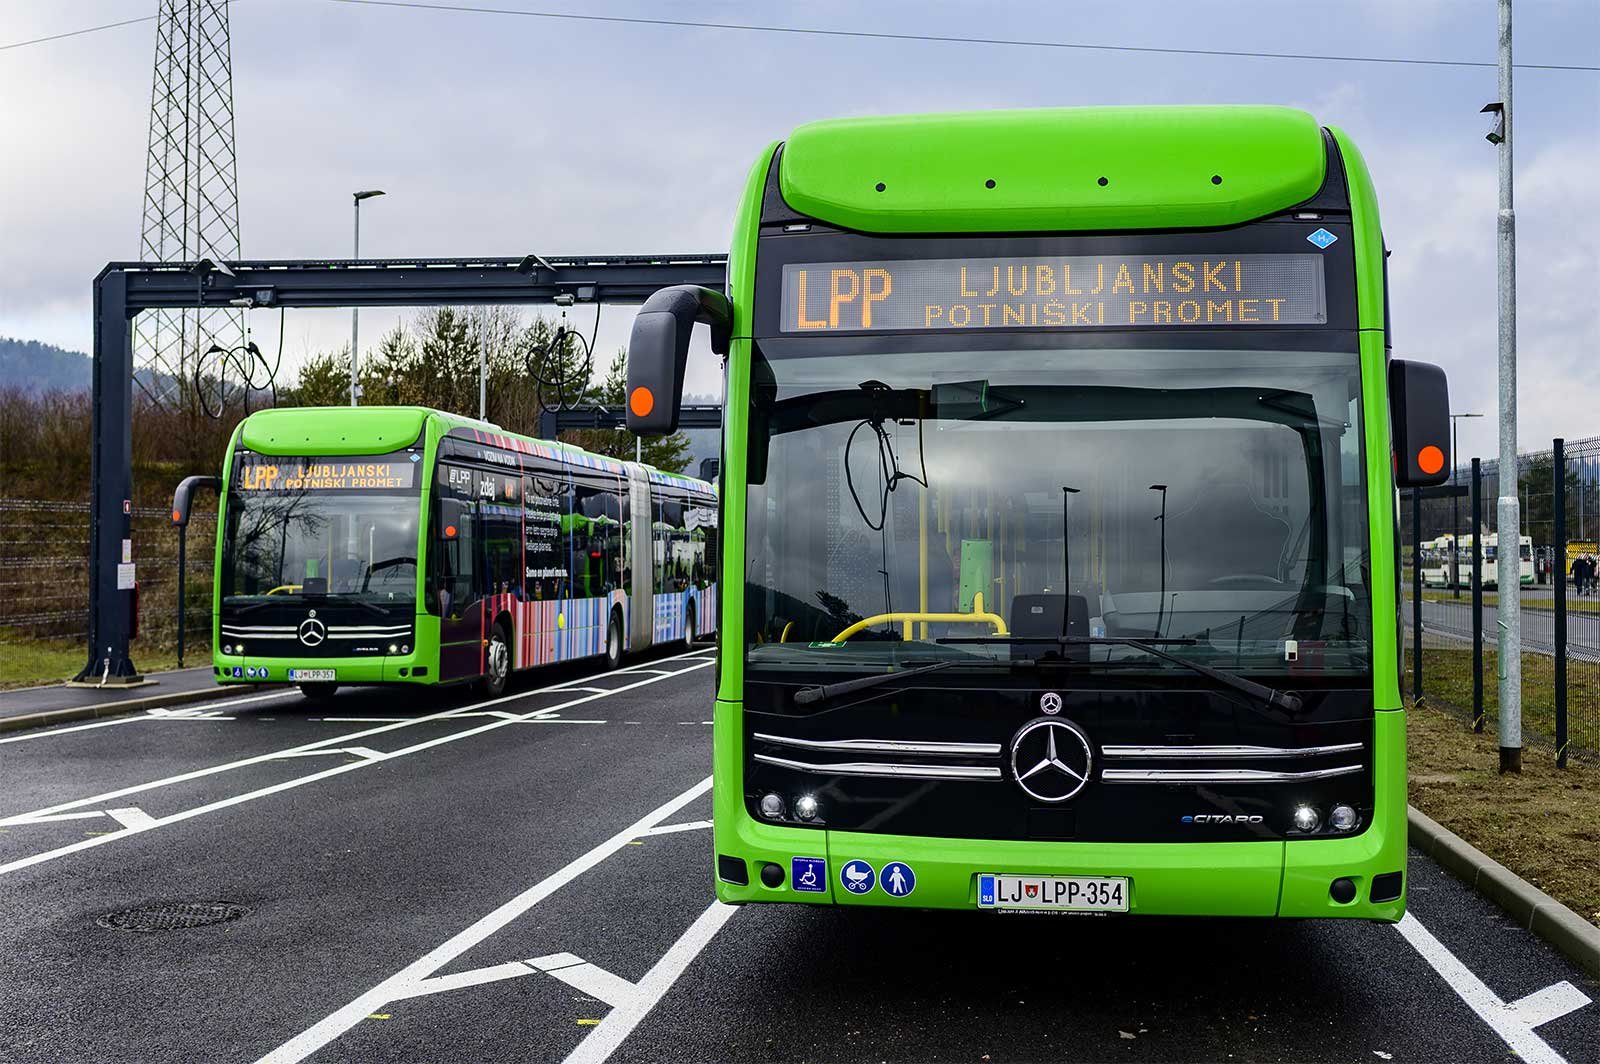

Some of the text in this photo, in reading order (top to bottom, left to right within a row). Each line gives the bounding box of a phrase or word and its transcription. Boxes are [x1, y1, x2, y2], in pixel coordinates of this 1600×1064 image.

[959, 260, 1243, 297] LJUBLJANSKI
[797, 268, 892, 329] LPP
[924, 297, 1287, 328] POTNIŠKI PROMET
[244, 465, 279, 489] LPP
[286, 477, 402, 488] POTNIŠKI PROMET
[298, 464, 391, 478] LJUBLJANSKI
[480, 476, 496, 501] zdaj
[1181, 814, 1264, 824] eCITARO
[997, 879, 1123, 905] LJ LPP-354
